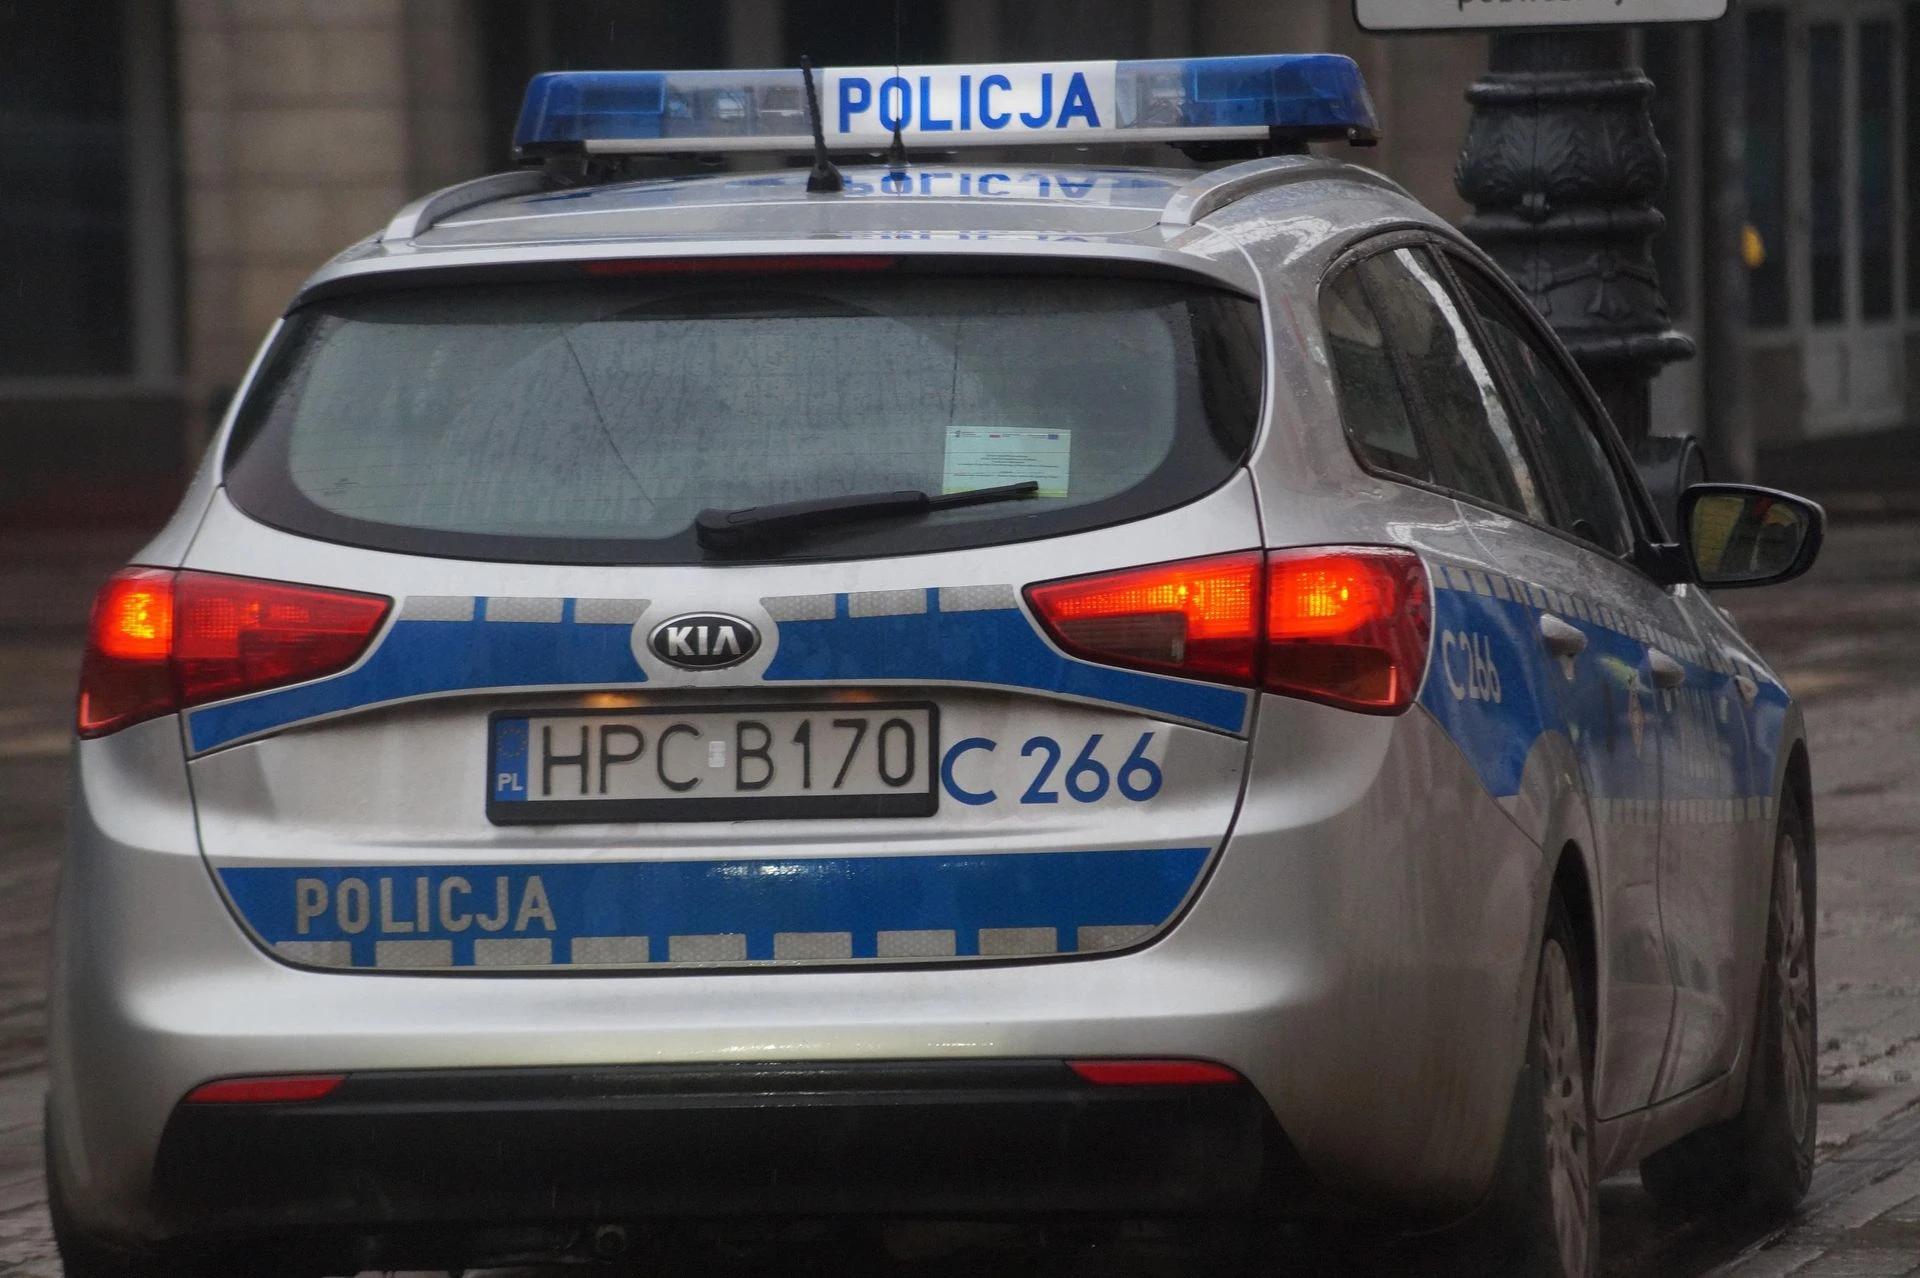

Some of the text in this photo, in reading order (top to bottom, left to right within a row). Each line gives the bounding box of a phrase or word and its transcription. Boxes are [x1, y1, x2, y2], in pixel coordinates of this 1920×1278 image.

[839, 72, 1101, 133] POLICJA
[667, 625, 742, 656] KIA
[498, 773, 523, 791] PL
[542, 718, 915, 796] HPC B170
[941, 732, 1162, 806] C 266
[296, 876, 557, 934] POLICJA
